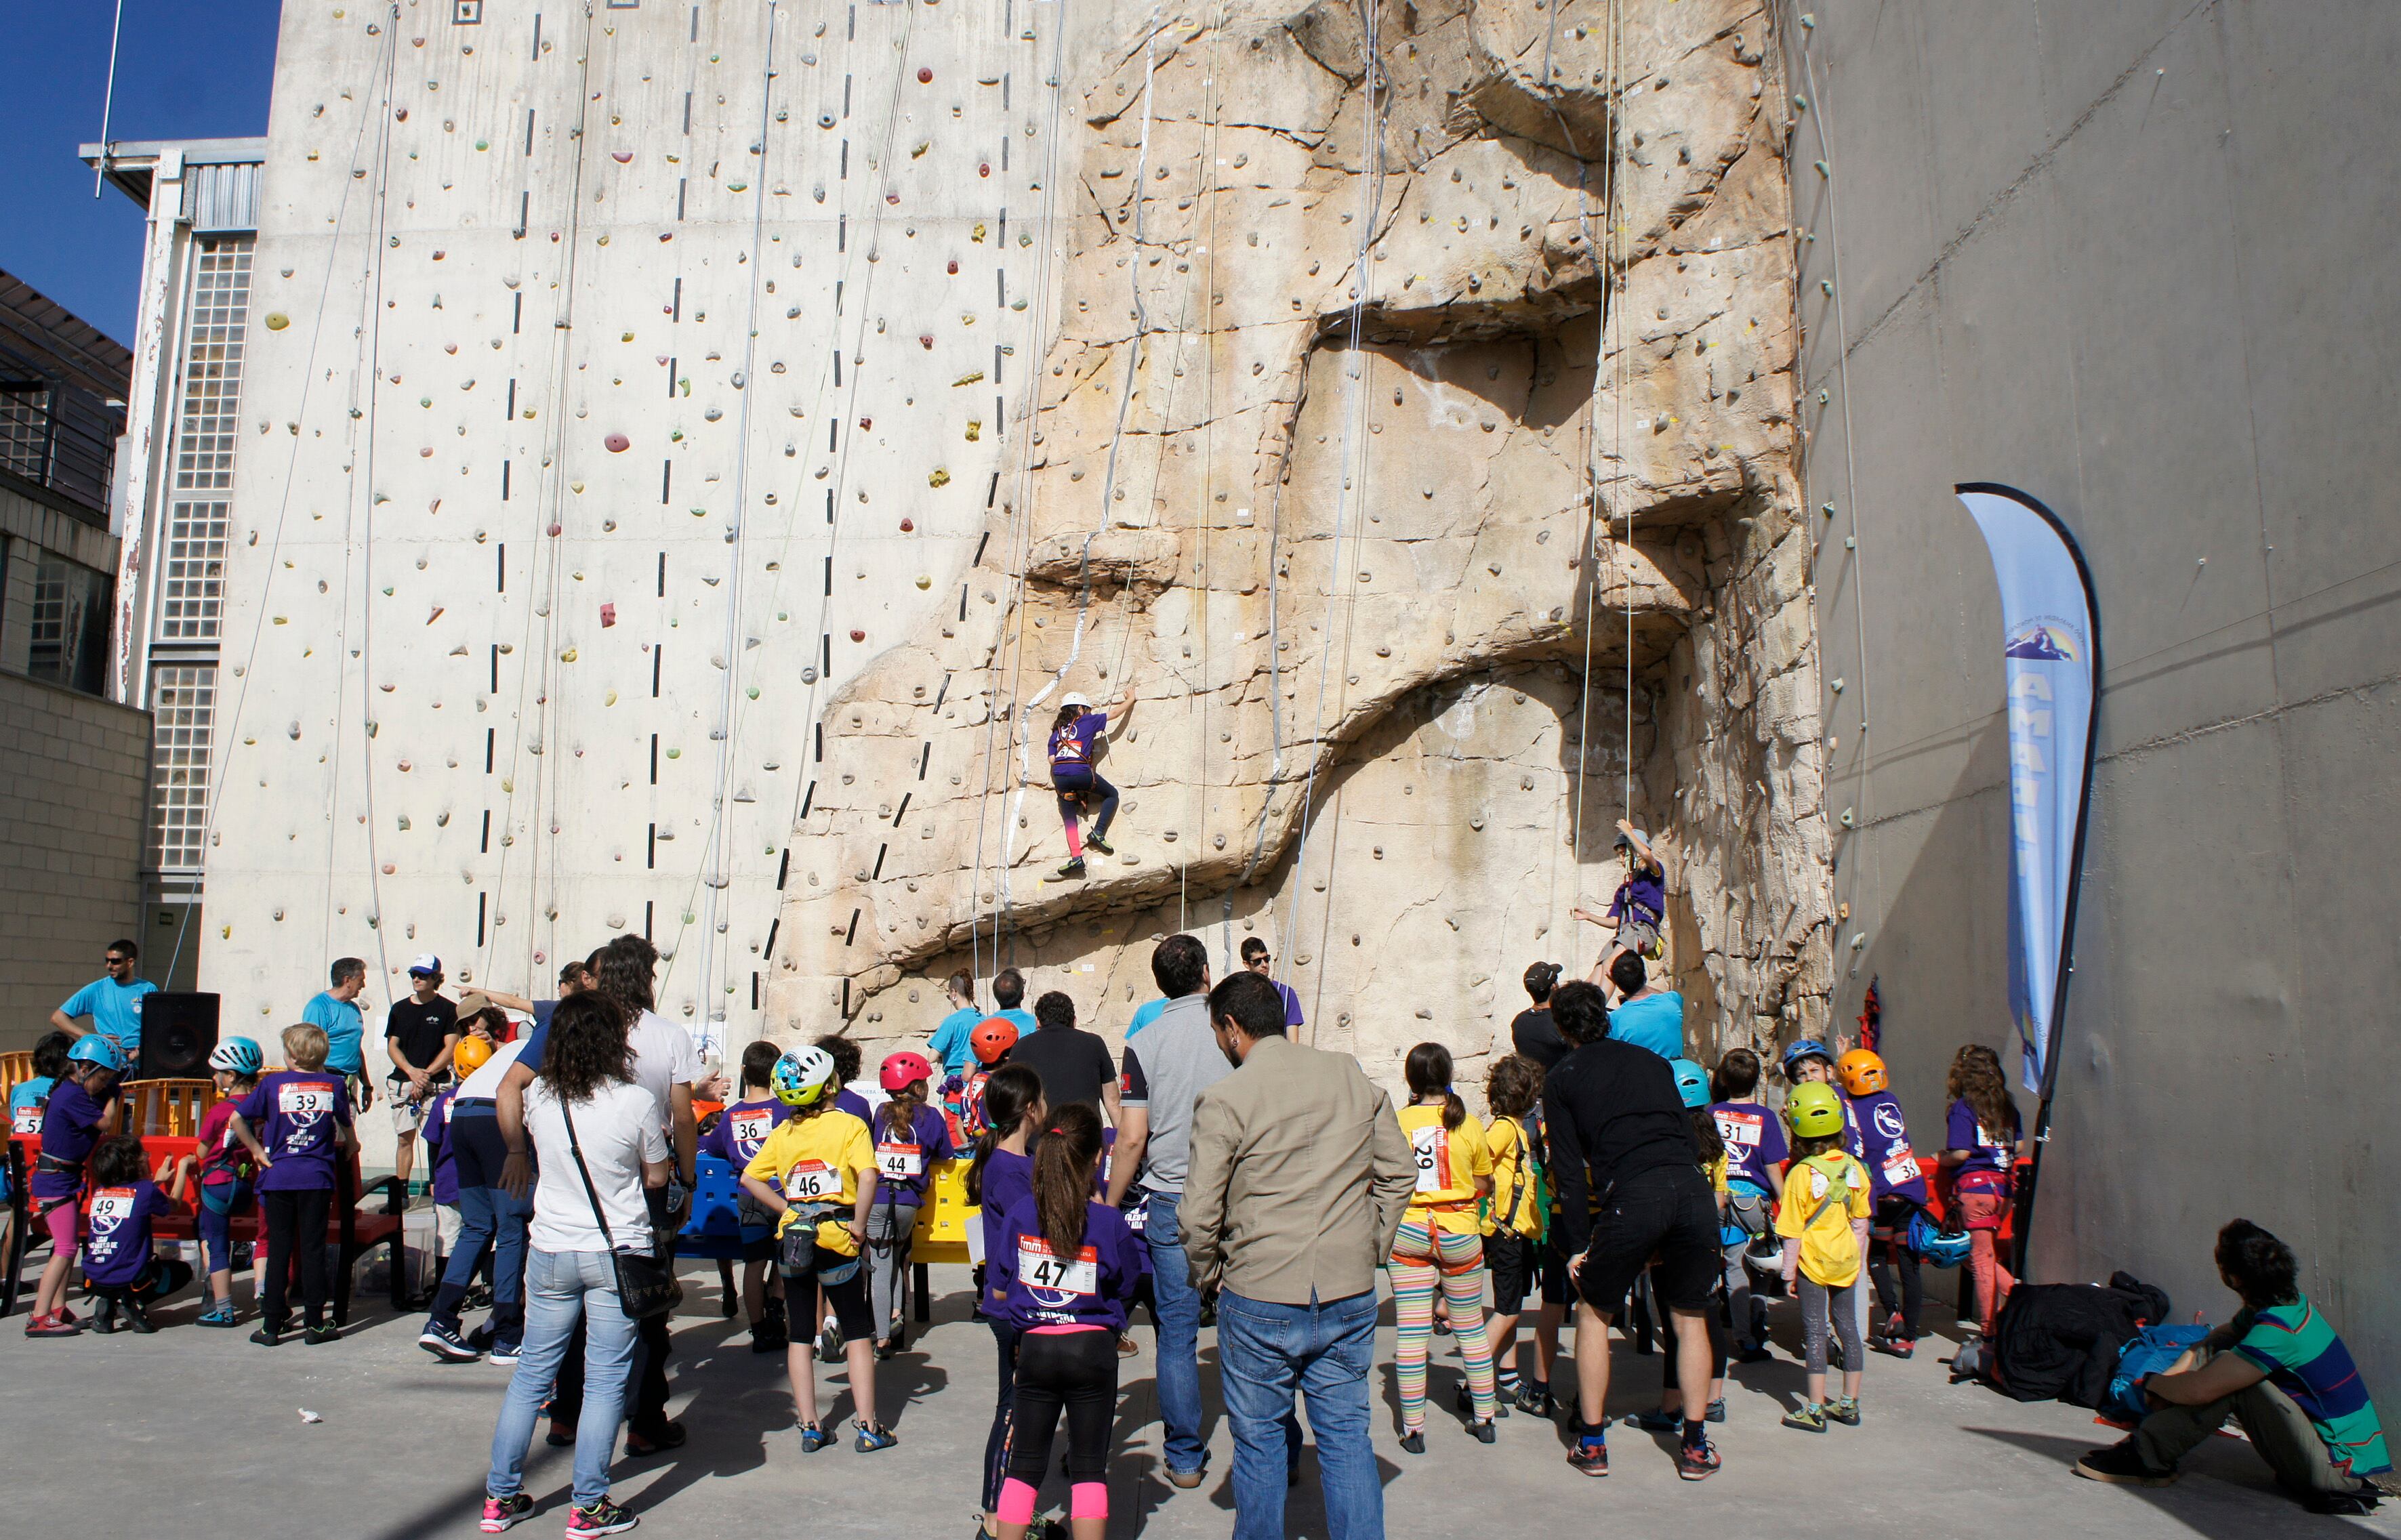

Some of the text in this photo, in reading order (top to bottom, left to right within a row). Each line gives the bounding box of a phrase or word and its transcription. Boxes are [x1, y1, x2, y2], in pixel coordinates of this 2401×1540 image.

[296, 1094, 317, 1110] 39
[18, 1107, 32, 1116] fmm
[740, 1123, 758, 1140] 36
[1435, 1128, 1447, 1147] fmm
[1723, 1124, 1741, 1141] 31
[888, 1156, 906, 1172] 44
[1414, 1145, 1434, 1169] 29
[799, 1175, 821, 1196] 46
[96, 1200, 115, 1215] 49
[1021, 1236, 1041, 1253] fmm
[1033, 1260, 1067, 1287] 47
